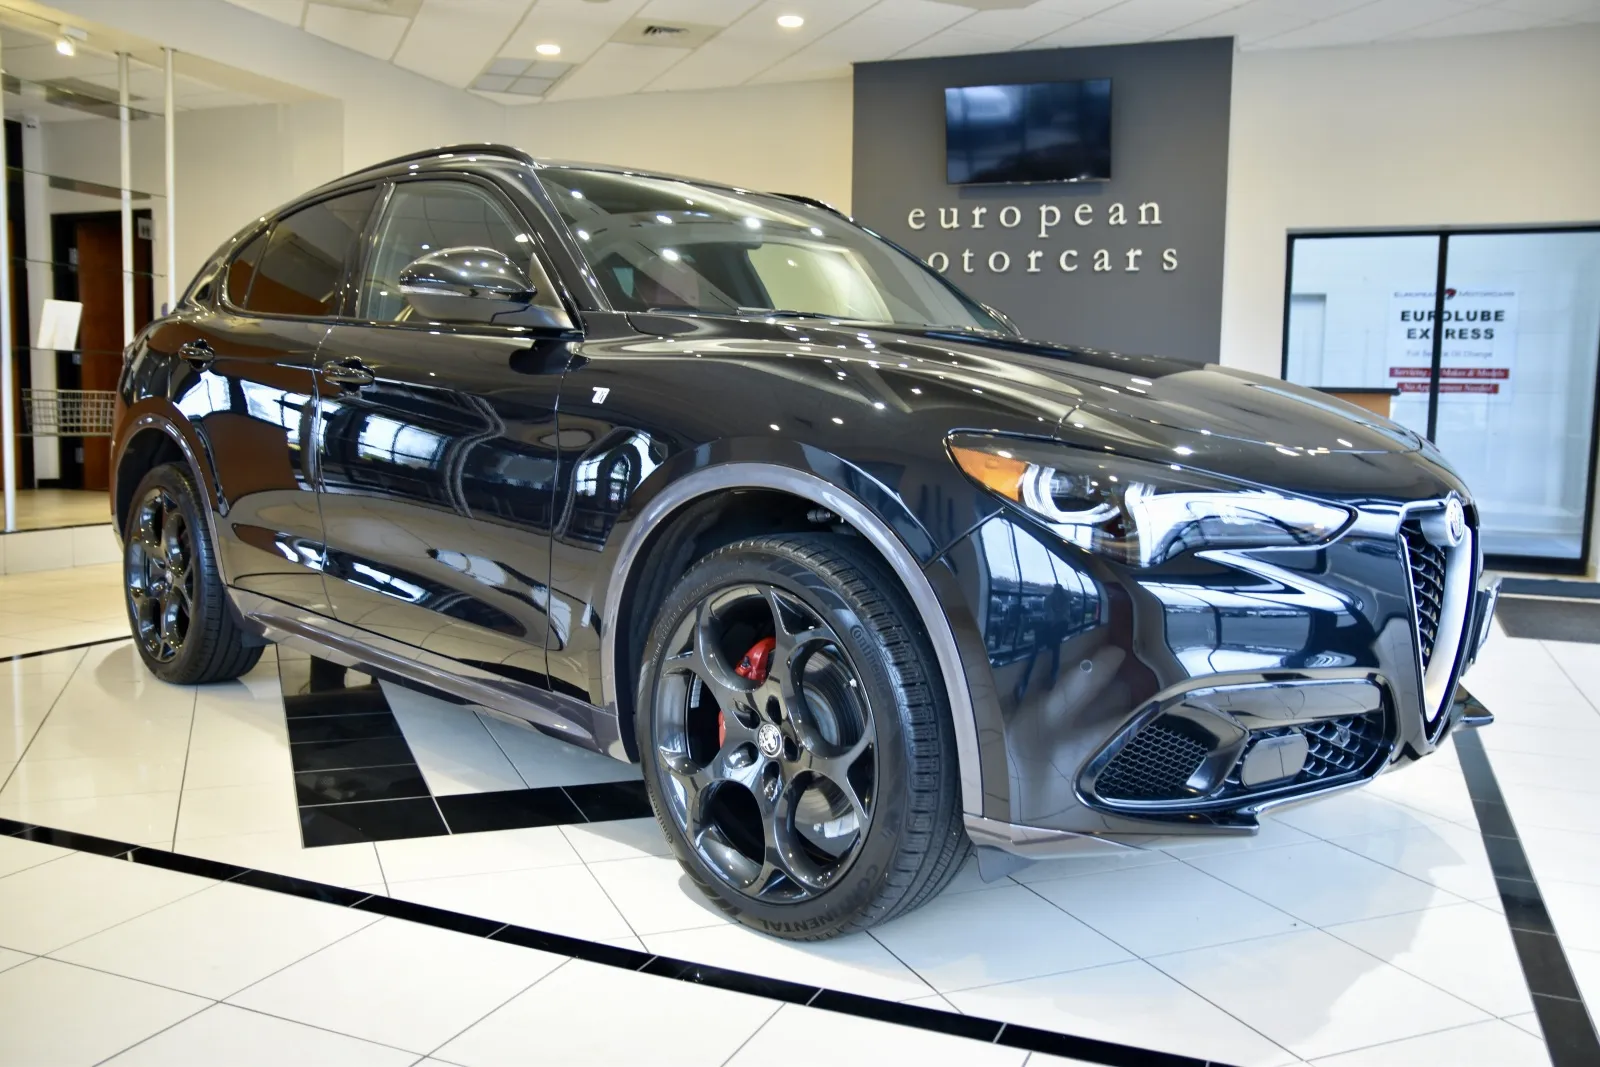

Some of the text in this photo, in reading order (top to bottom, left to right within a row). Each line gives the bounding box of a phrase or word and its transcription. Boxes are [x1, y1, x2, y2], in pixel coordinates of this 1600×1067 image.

[908, 200, 1162, 238] european
[927, 247, 1178, 273] otorcars
[1407, 328, 1495, 340] EXRESS
